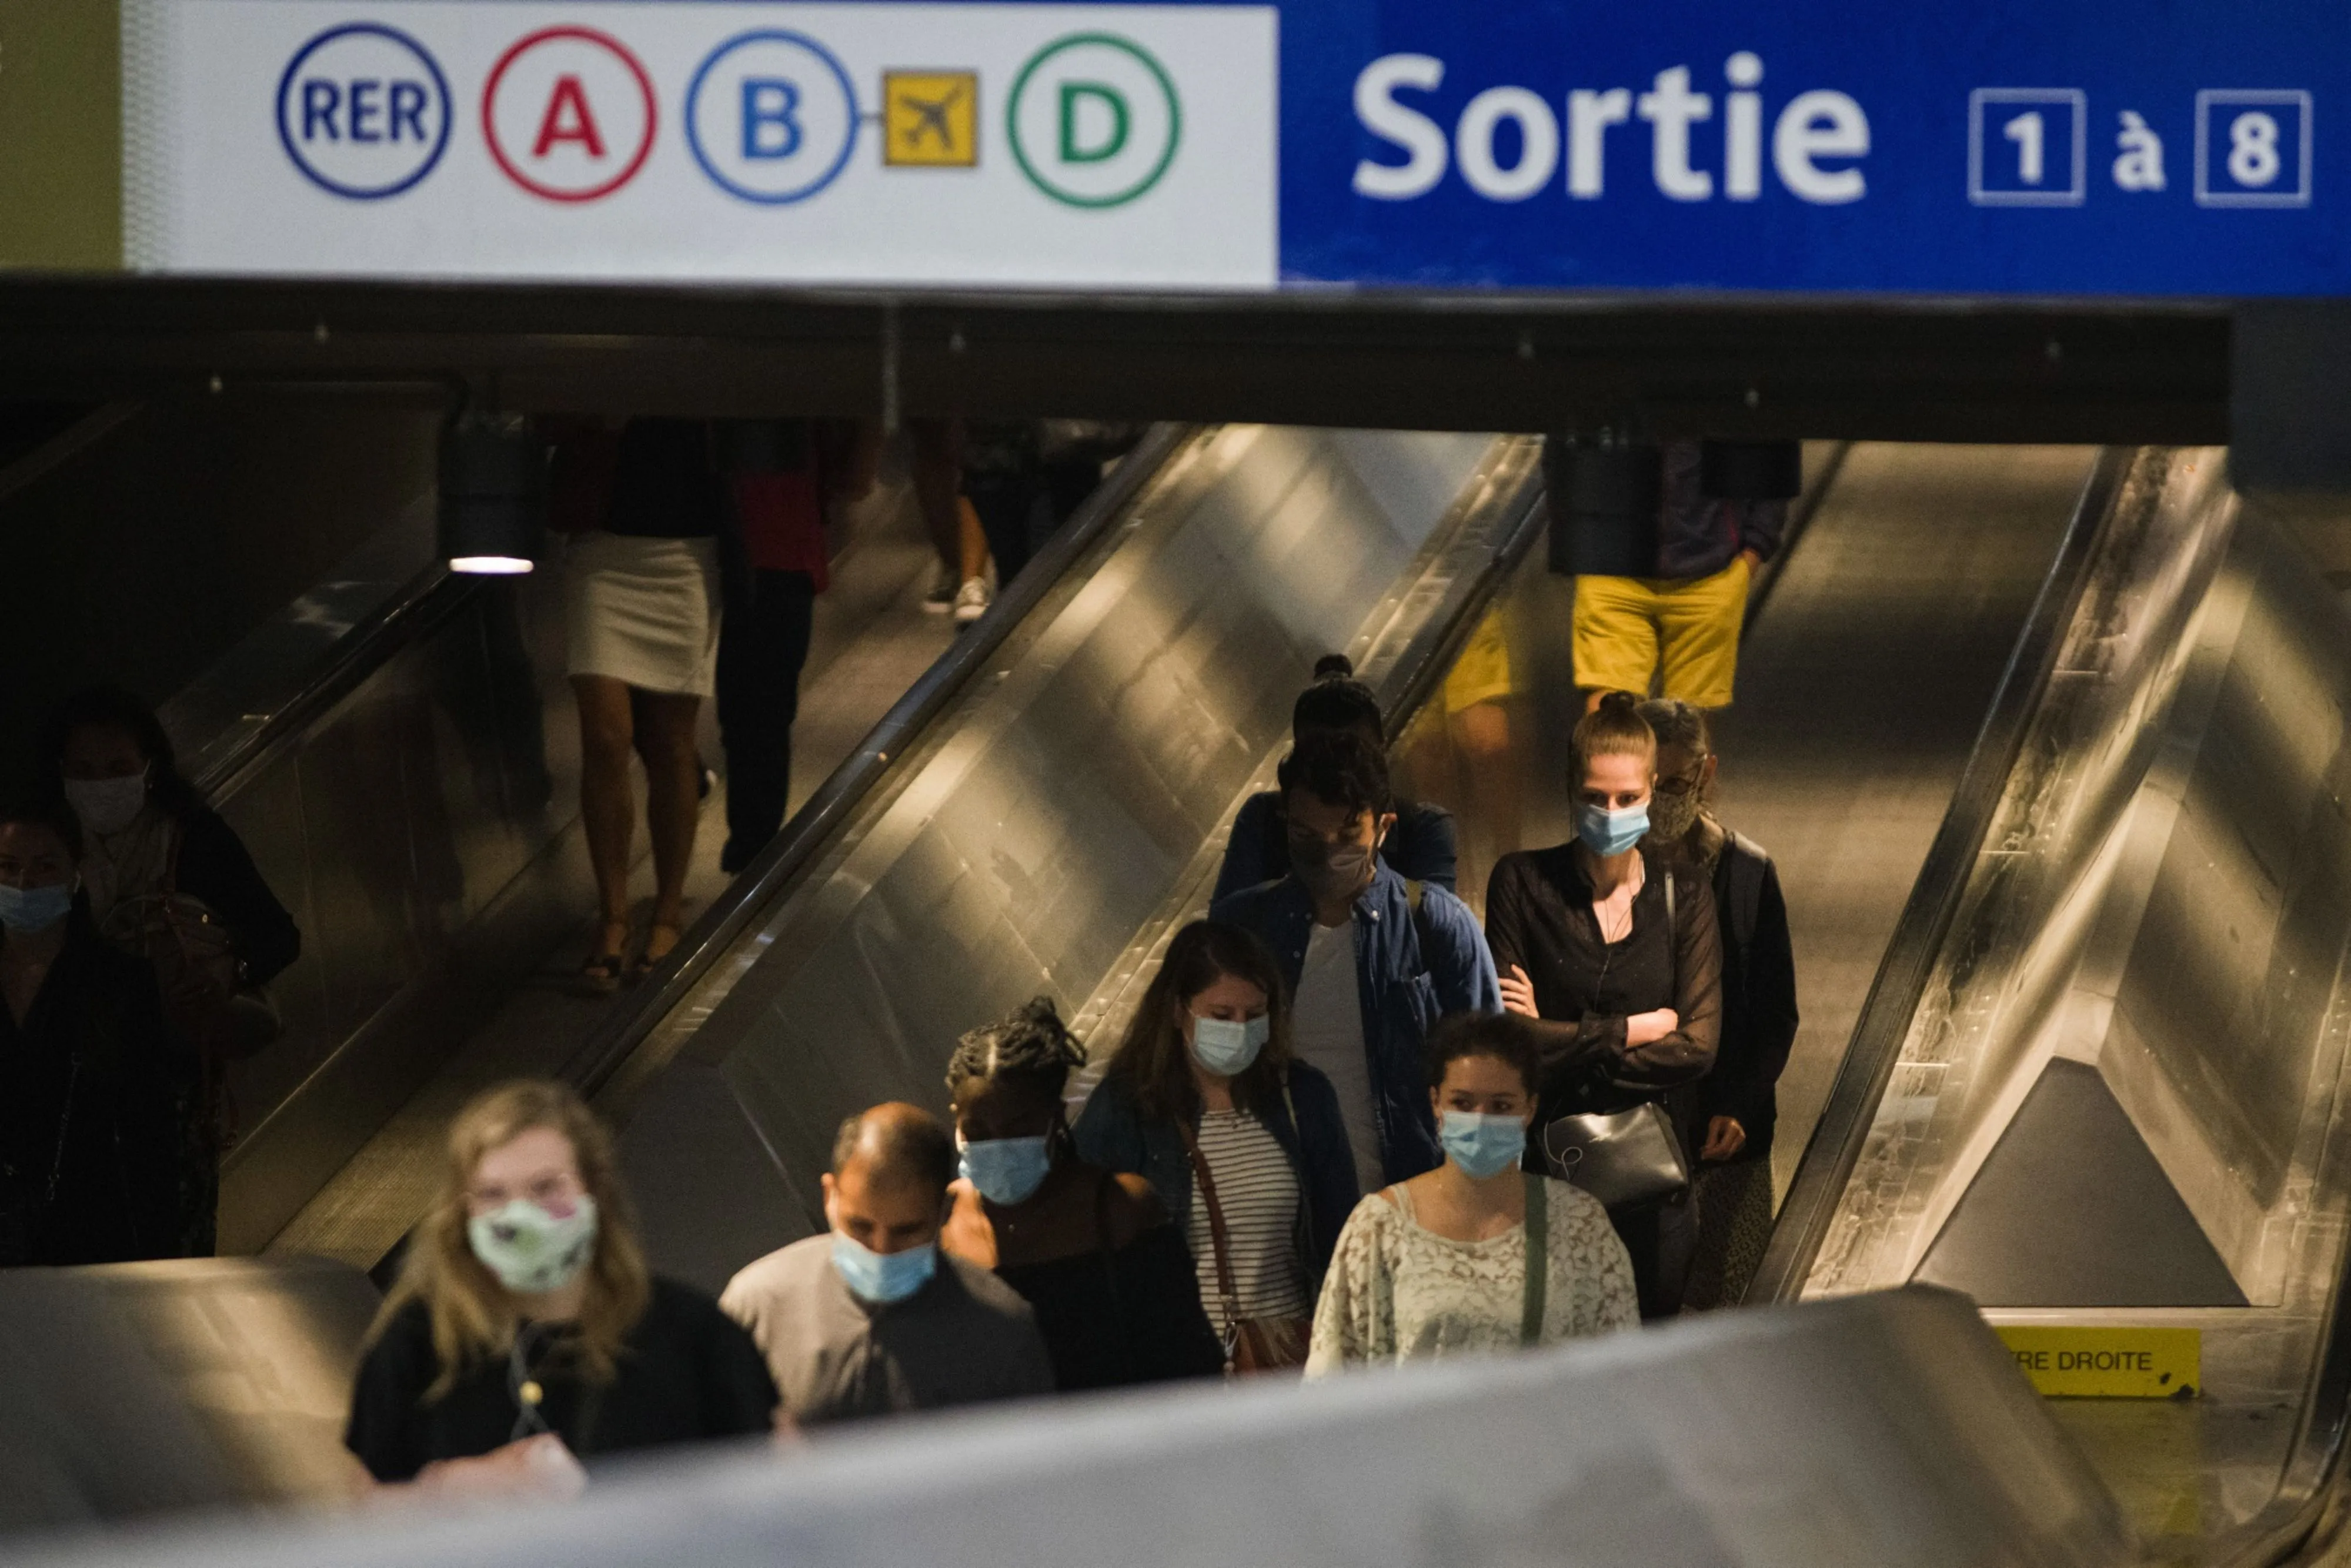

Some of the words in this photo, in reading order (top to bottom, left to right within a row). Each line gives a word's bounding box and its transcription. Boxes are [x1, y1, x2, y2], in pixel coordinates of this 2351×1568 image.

[302, 78, 429, 143] RER
[532, 75, 605, 158] A
[740, 78, 803, 161] B
[1058, 82, 1131, 165] D
[1353, 51, 1871, 204] Sortie
[2004, 112, 2043, 183] 1
[2113, 111, 2166, 190] à
[2228, 112, 2280, 186] 8
[2058, 1350, 2153, 1370] DROITE
